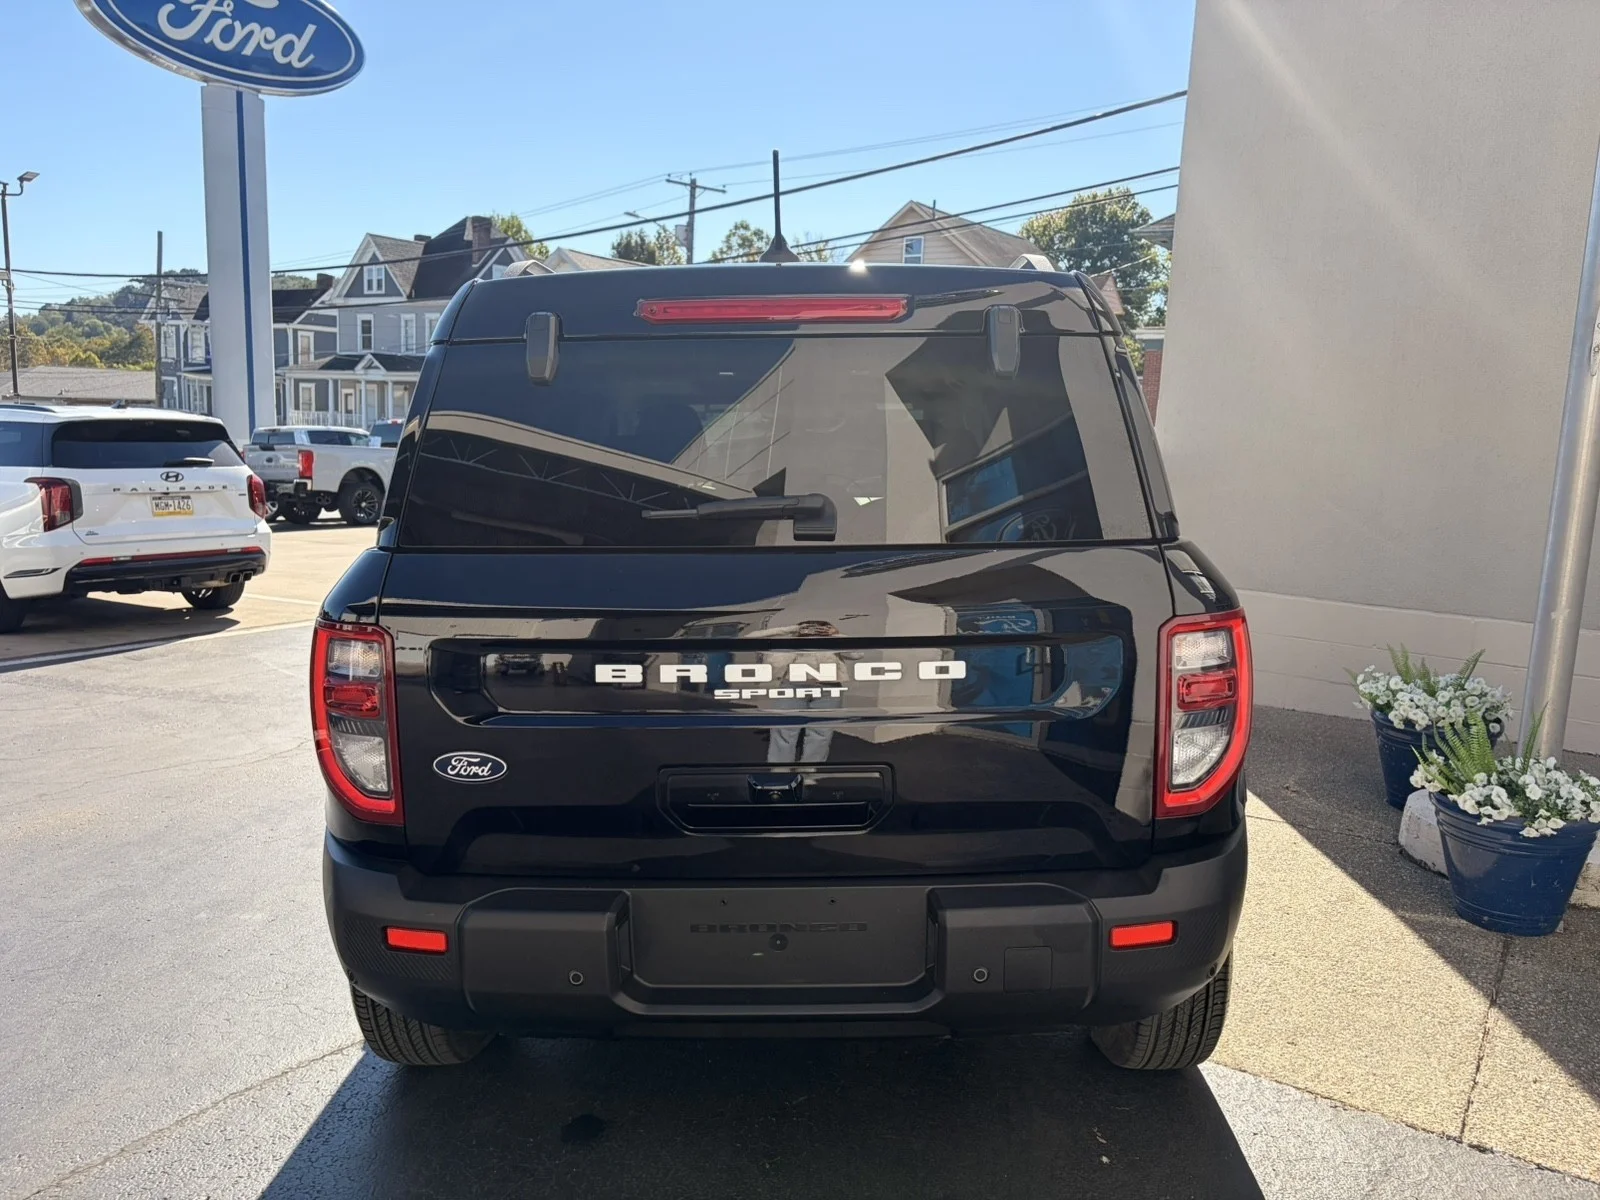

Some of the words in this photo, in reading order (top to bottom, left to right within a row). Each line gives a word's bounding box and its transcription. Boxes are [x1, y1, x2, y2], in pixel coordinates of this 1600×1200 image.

[157, 0, 318, 69] Ford
[112, 485, 228, 493] PALISADE
[595, 660, 967, 683] BRONCO
[714, 687, 848, 700] SPORT
[447, 756, 493, 776] Ford
[690, 922, 867, 933] BRONCO
